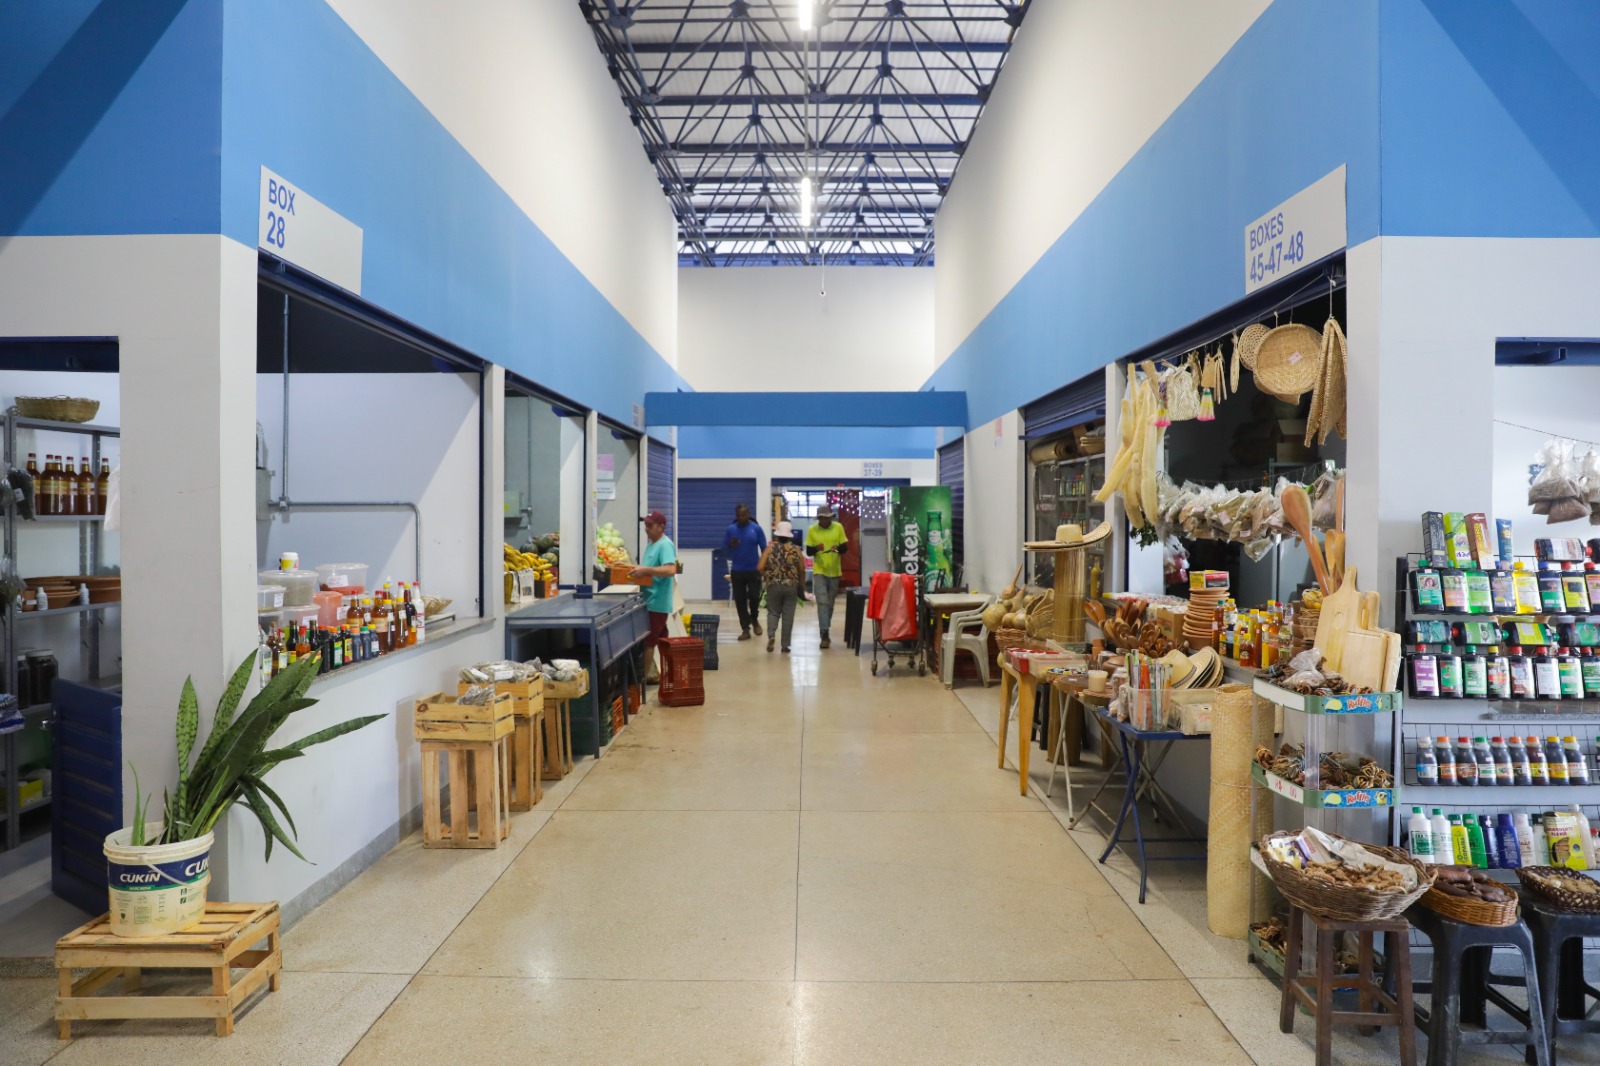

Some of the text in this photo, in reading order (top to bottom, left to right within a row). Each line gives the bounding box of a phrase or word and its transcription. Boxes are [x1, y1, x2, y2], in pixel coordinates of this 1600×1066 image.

[268, 178, 296, 216] BOX
[266, 210, 286, 249] 28
[1250, 212, 1284, 251] BOXES
[1250, 230, 1304, 284] 45-47-48
[863, 469, 882, 477] 37-39
[120, 873, 161, 883] CUKIN
